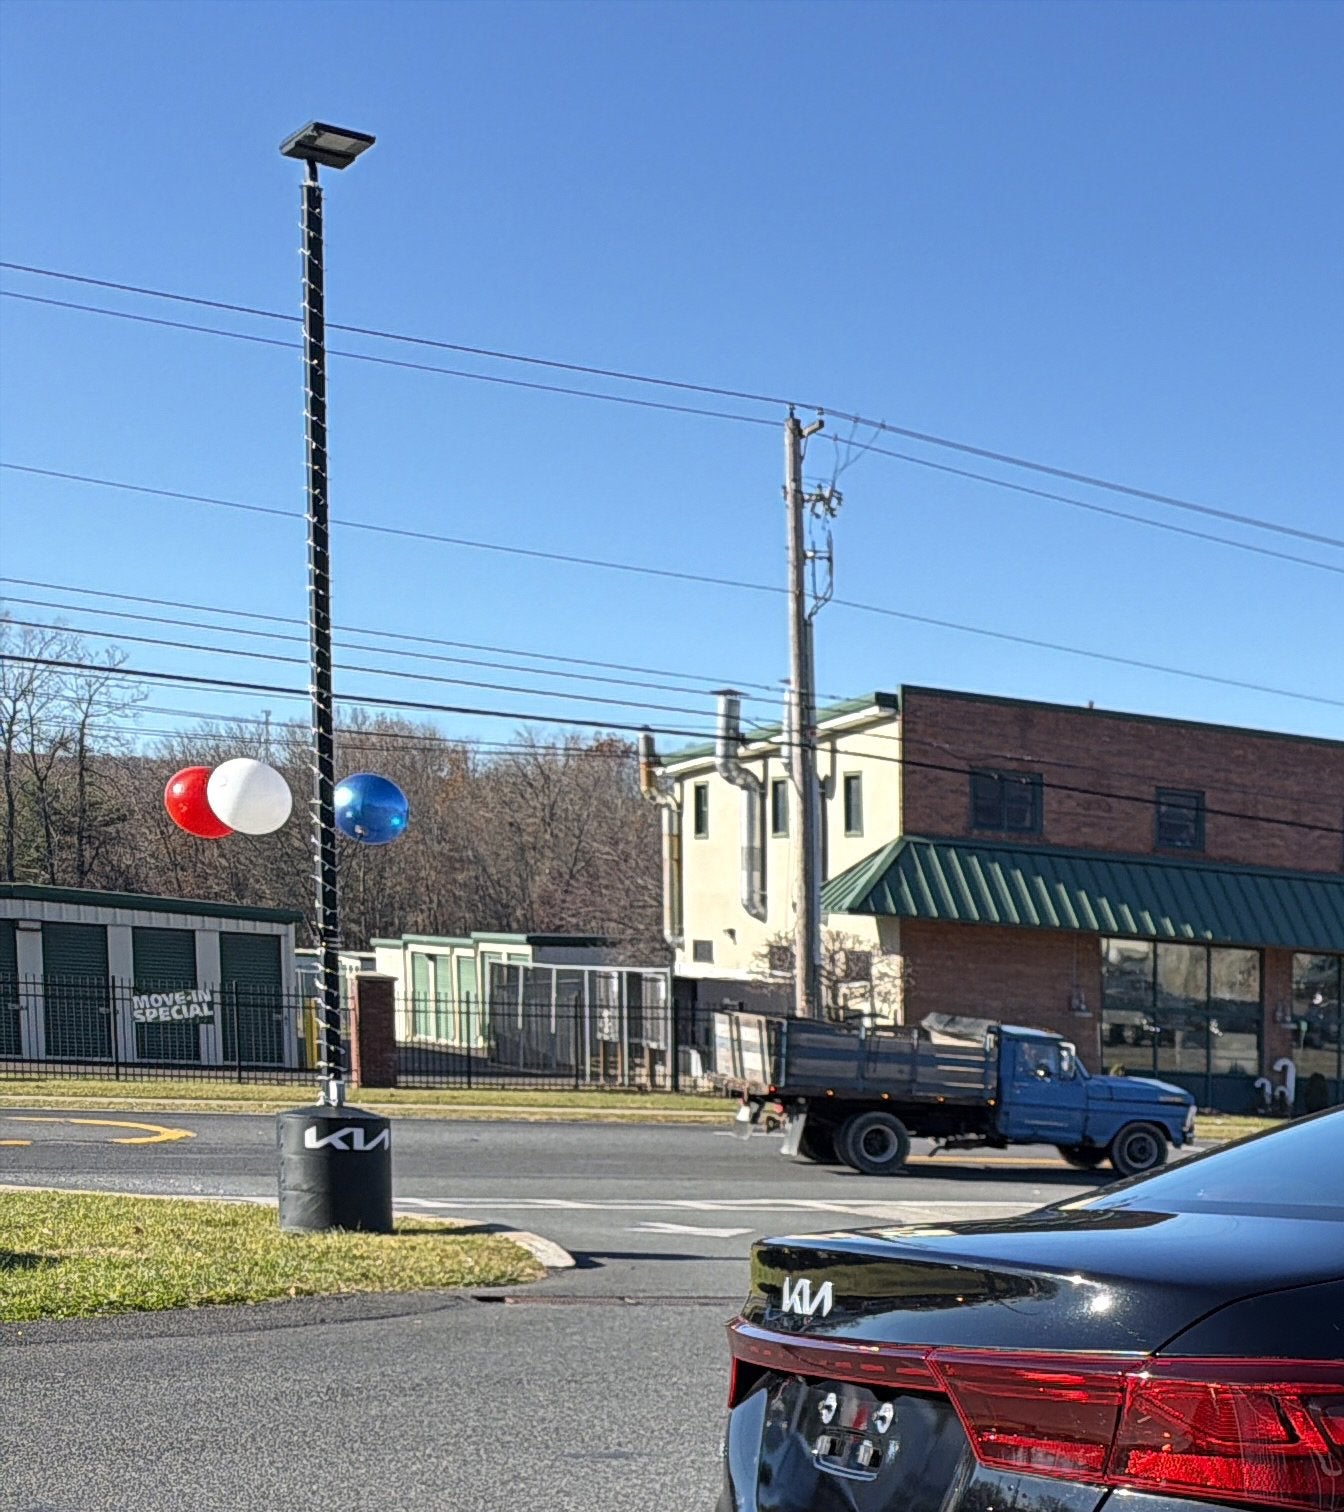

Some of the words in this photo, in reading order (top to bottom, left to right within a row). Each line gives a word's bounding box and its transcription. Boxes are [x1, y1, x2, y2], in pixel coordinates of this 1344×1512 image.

[132, 989, 212, 1009] MOVE-IN
[133, 1002, 214, 1023] SPECIAL
[304, 1125, 389, 1151] KIA
[781, 1276, 833, 1318] KIA
